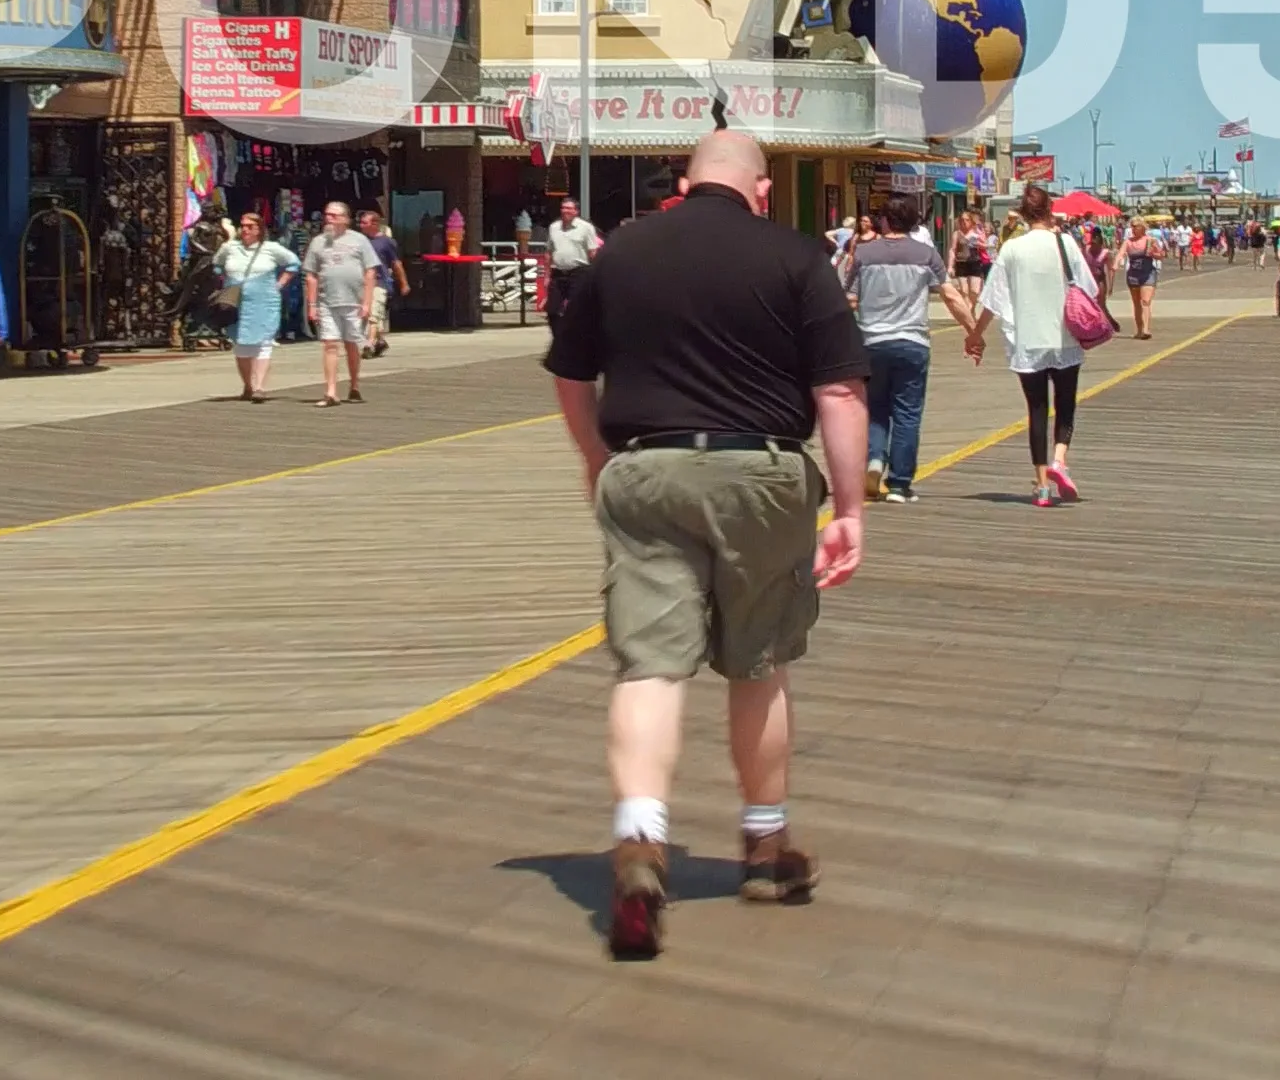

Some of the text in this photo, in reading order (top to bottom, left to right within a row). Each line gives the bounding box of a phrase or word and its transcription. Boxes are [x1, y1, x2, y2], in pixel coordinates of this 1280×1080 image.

[192, 21, 270, 35] Fine Cigars
[274, 21, 290, 40] H
[192, 35, 262, 49] Cigarettes
[318, 28, 398, 70] HOT SPOT III
[192, 47, 298, 61] Salt Water Taffy
[192, 60, 295, 72] Ice Cold Drinks
[191, 74, 275, 85] Beach Items
[191, 86, 281, 98] Henna Tattoo
[191, 99, 261, 111] Swimwear
[637, 88, 664, 120] It
[672, 95, 709, 120] or
[727, 84, 803, 120] Not!
